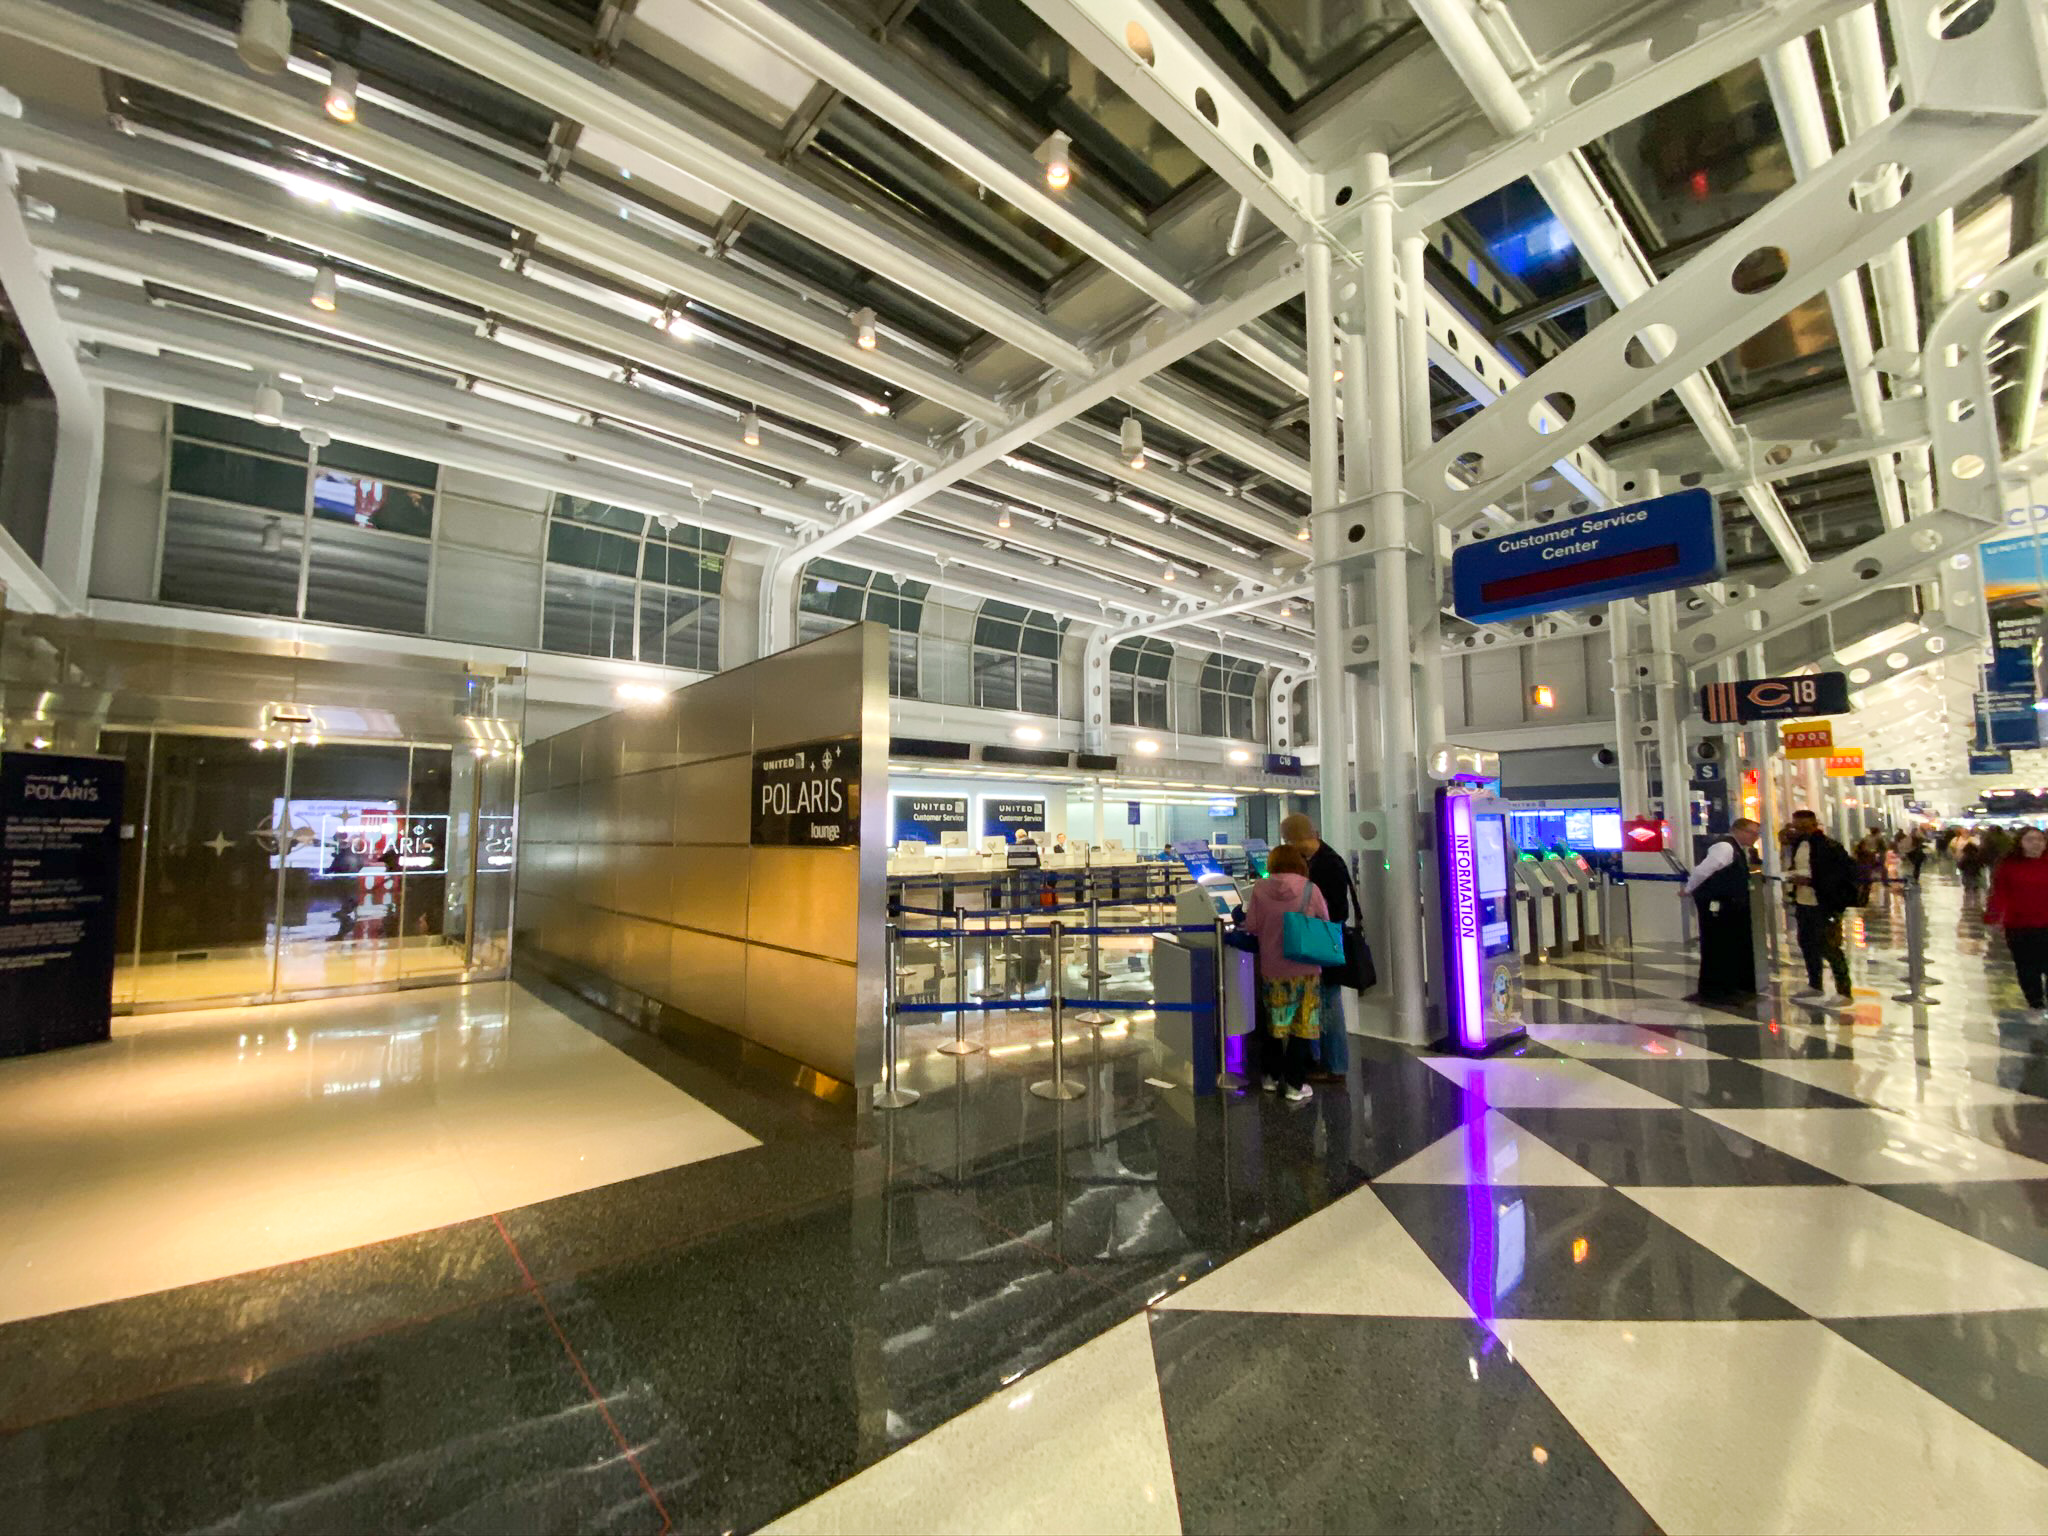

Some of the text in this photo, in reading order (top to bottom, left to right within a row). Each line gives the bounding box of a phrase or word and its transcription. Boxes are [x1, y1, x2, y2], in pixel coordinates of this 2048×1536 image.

[1499, 509, 1648, 553] Customer Service
[1541, 539, 1600, 561] Center
[1787, 731, 1827, 743] FOOD
[763, 758, 795, 771] UNITED
[24, 784, 98, 801] POLARIS
[762, 777, 843, 816] POLARIS
[913, 802, 953, 811] UNITED
[999, 804, 1032, 813] UNITED
[913, 813, 965, 822] Customer Service
[811, 822, 839, 842] lounge
[1456, 834, 1475, 938] INFORMATION
